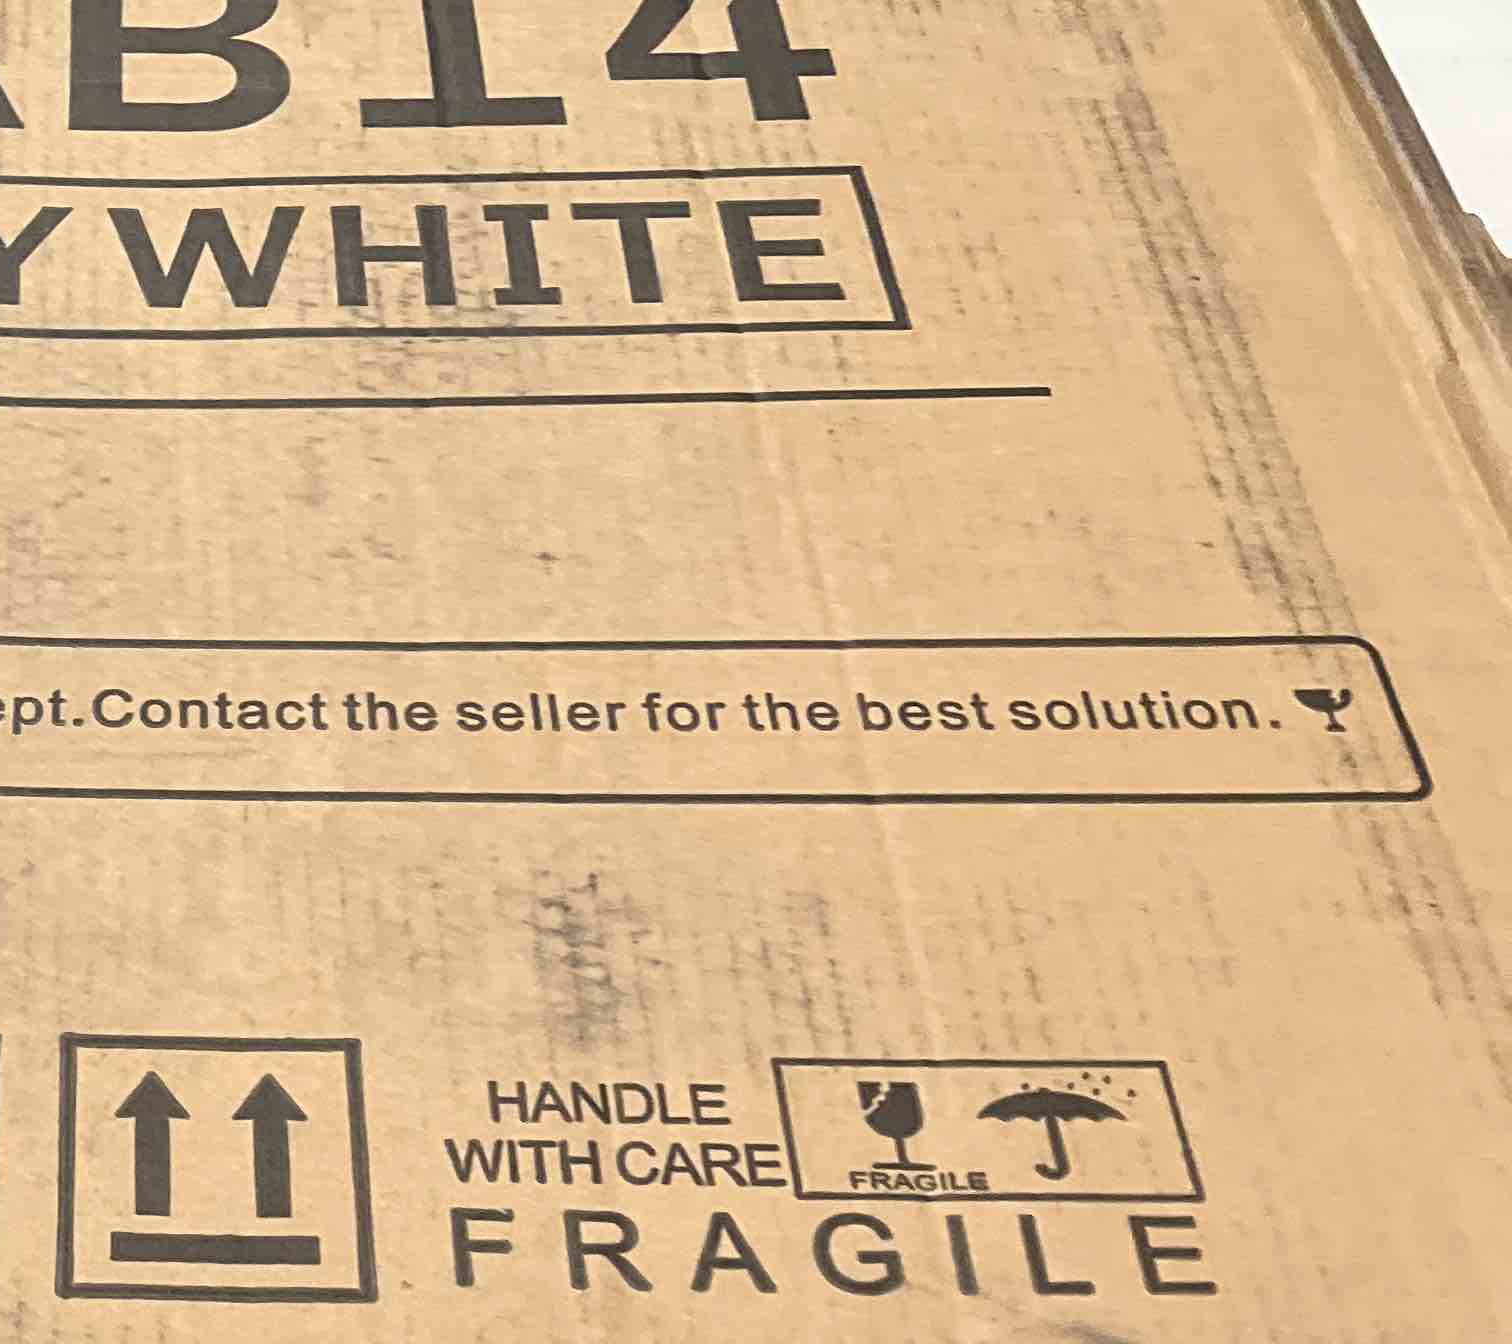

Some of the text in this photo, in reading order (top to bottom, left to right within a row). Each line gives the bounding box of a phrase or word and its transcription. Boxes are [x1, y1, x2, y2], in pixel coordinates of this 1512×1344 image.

[343, 691, 439, 732] the
[456, 691, 627, 733] seller
[640, 692, 725, 733] for
[743, 691, 841, 732] the
[857, 691, 994, 733] best
[1009, 689, 1282, 732] solution.
[487, 1080, 732, 1127] HANDLE
[444, 1137, 789, 1189] WITH CARE
[849, 1170, 990, 1192] FRAGILE
[450, 1208, 1217, 1297] FRAGILE
